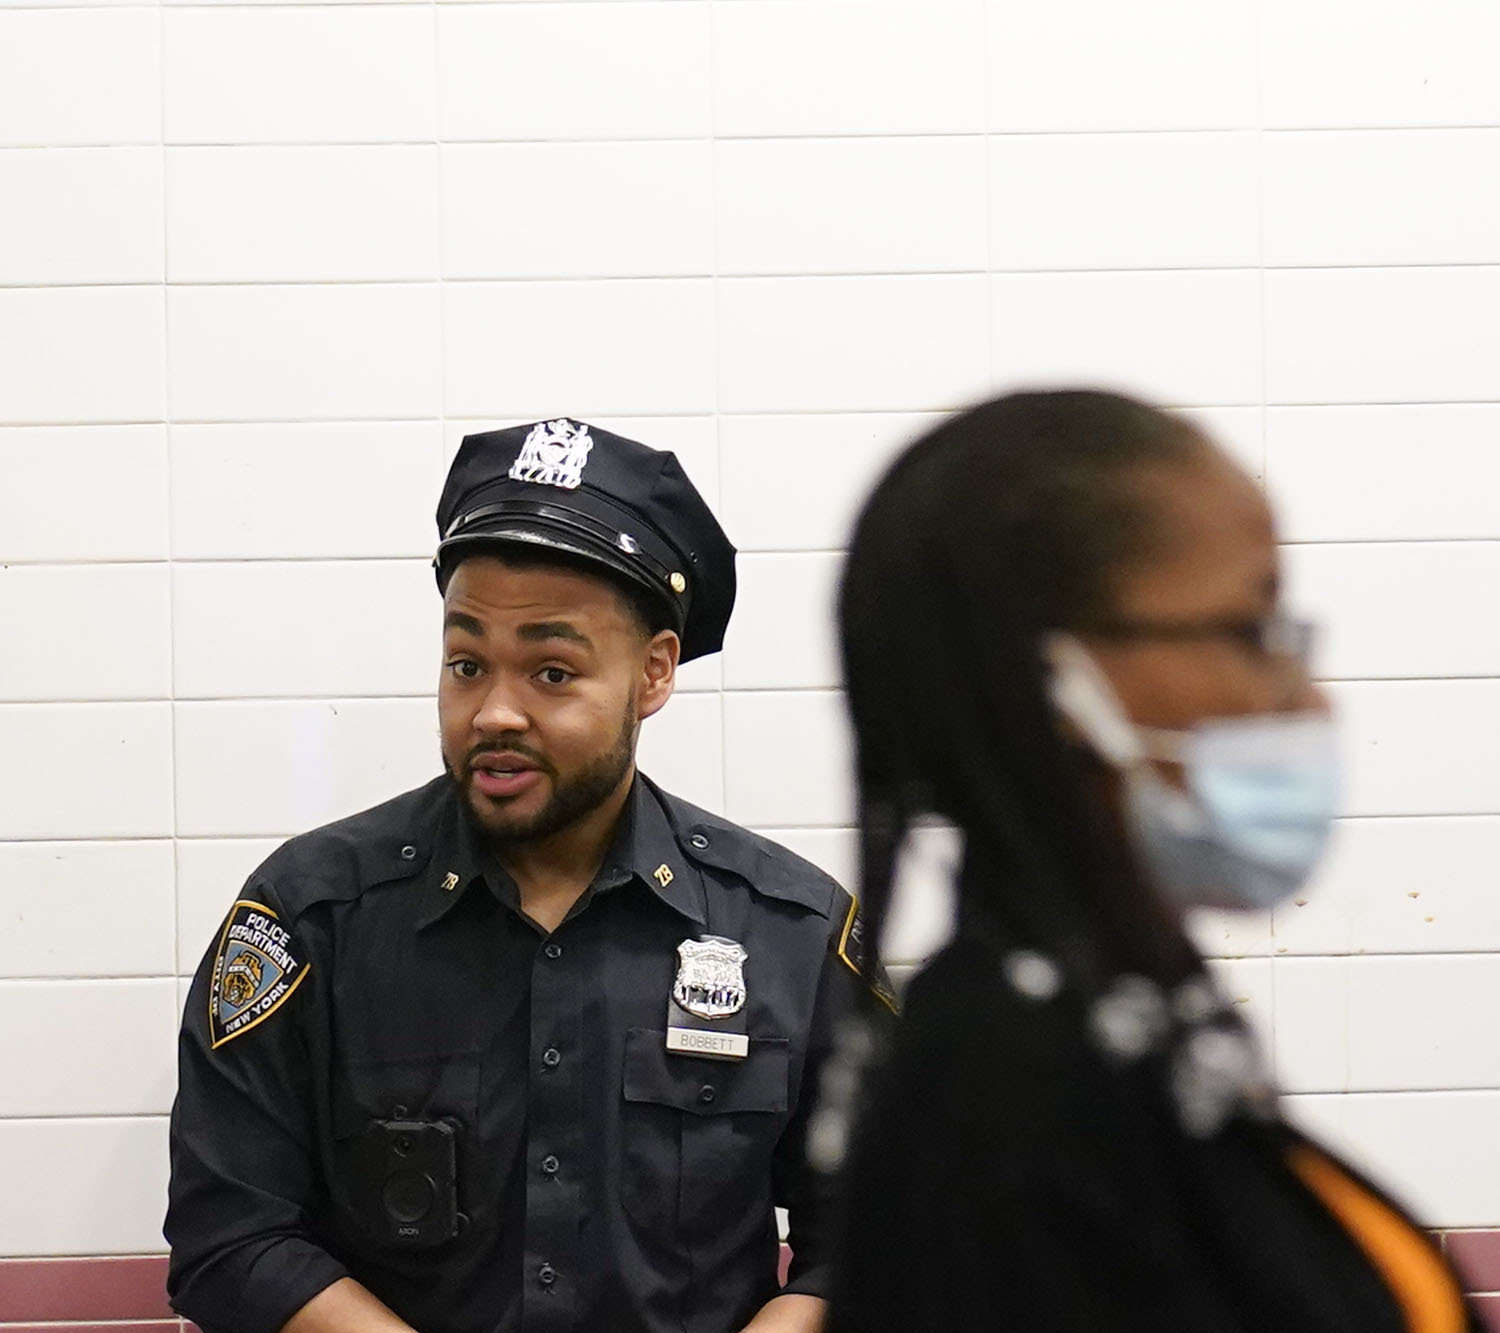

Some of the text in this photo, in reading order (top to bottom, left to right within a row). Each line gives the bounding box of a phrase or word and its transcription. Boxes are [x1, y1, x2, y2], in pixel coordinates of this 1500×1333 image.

[228, 925, 299, 974] DEPARTMENT
[246, 913, 291, 947] POLICE
[226, 981, 289, 1034] NEW YORK
[681, 1034, 734, 1051] BOBBETT
